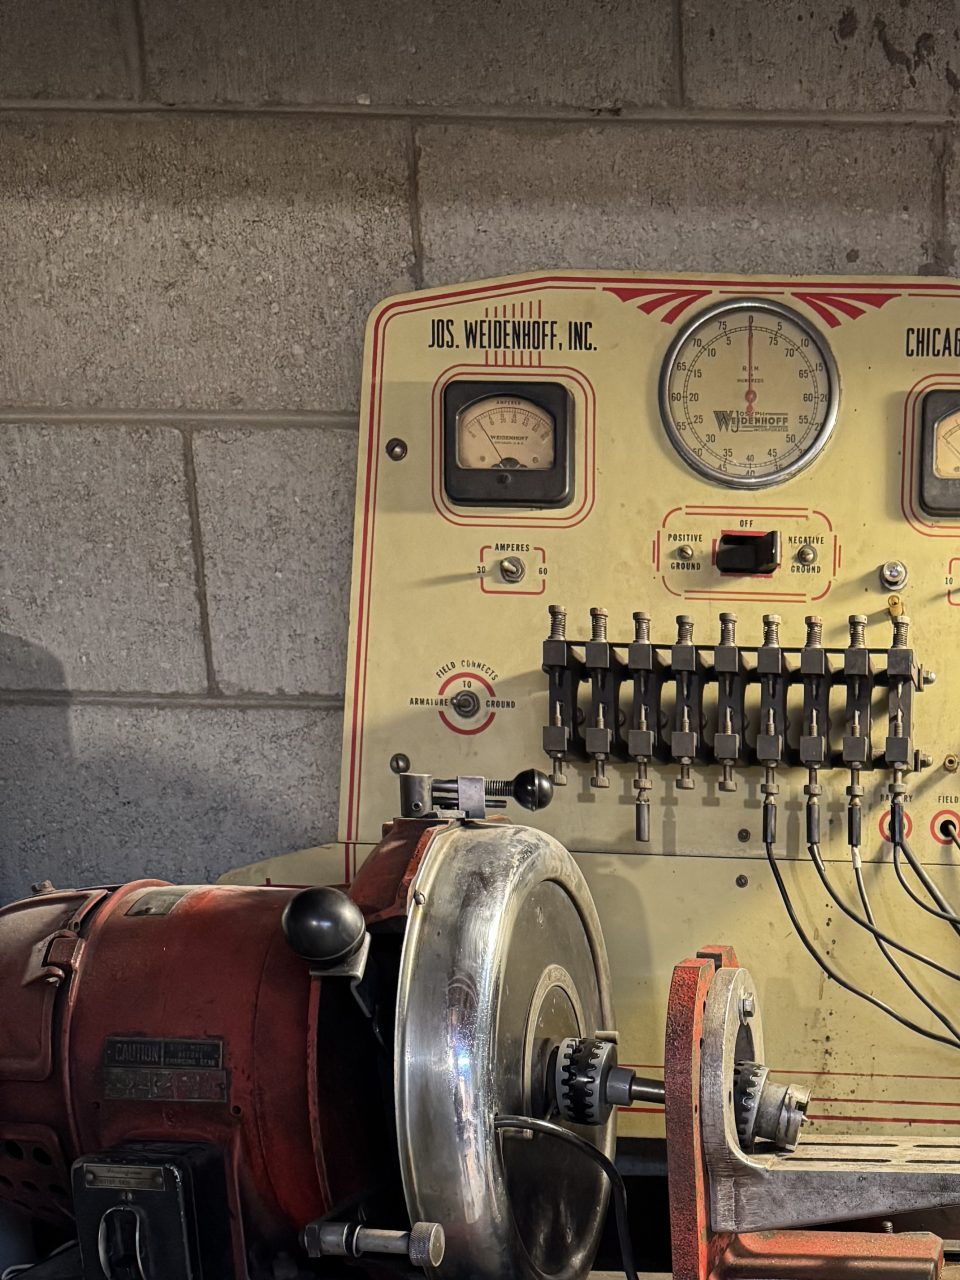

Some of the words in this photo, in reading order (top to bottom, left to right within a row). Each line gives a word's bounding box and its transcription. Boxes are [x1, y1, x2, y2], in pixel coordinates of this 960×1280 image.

[718, 321, 727, 330] 75
[428, 319, 459, 348] JOS.
[464, 319, 563, 351] WEIDENHOFF,
[568, 321, 597, 351] INC.
[692, 338, 702, 347] 70
[769, 336, 778, 345] 75
[800, 338, 809, 347] 10
[707, 348, 716, 357] 10
[785, 348, 794, 357] 70
[676, 362, 686, 371] 65
[815, 362, 823, 371] 15
[693, 370, 702, 378] 15
[799, 370, 808, 378] 65
[671, 393, 681, 402] 60
[689, 393, 699, 402] 20
[803, 393, 813, 402] 60
[693, 415, 703, 424] 25
[799, 415, 808, 424] 55
[705, 434, 716, 443] 30
[785, 434, 796, 443] 50
[723, 449, 733, 458] 35
[767, 449, 777, 458] 45
[745, 454, 755, 463] 40
[740, 519, 754, 528] OFF
[667, 533, 703, 542] POSITIVE
[788, 536, 825, 545] NEGATIVE
[494, 543, 530, 552] AMPERES
[476, 565, 486, 574] 30
[538, 567, 548, 576] 60
[670, 562, 701, 571] GROUND
[790, 565, 821, 574] GROUND
[945, 577, 954, 585] 10
[436, 661, 457, 679] FIELD
[461, 660, 499, 681] CONNECTS
[462, 680, 472, 689] TO
[409, 697, 449, 707] ARMATURE
[485, 699, 516, 709] GROUND
[880, 794, 913, 802] BARY
[938, 795, 959, 804] FIELD
[115, 1043, 159, 1062] CAUTION
